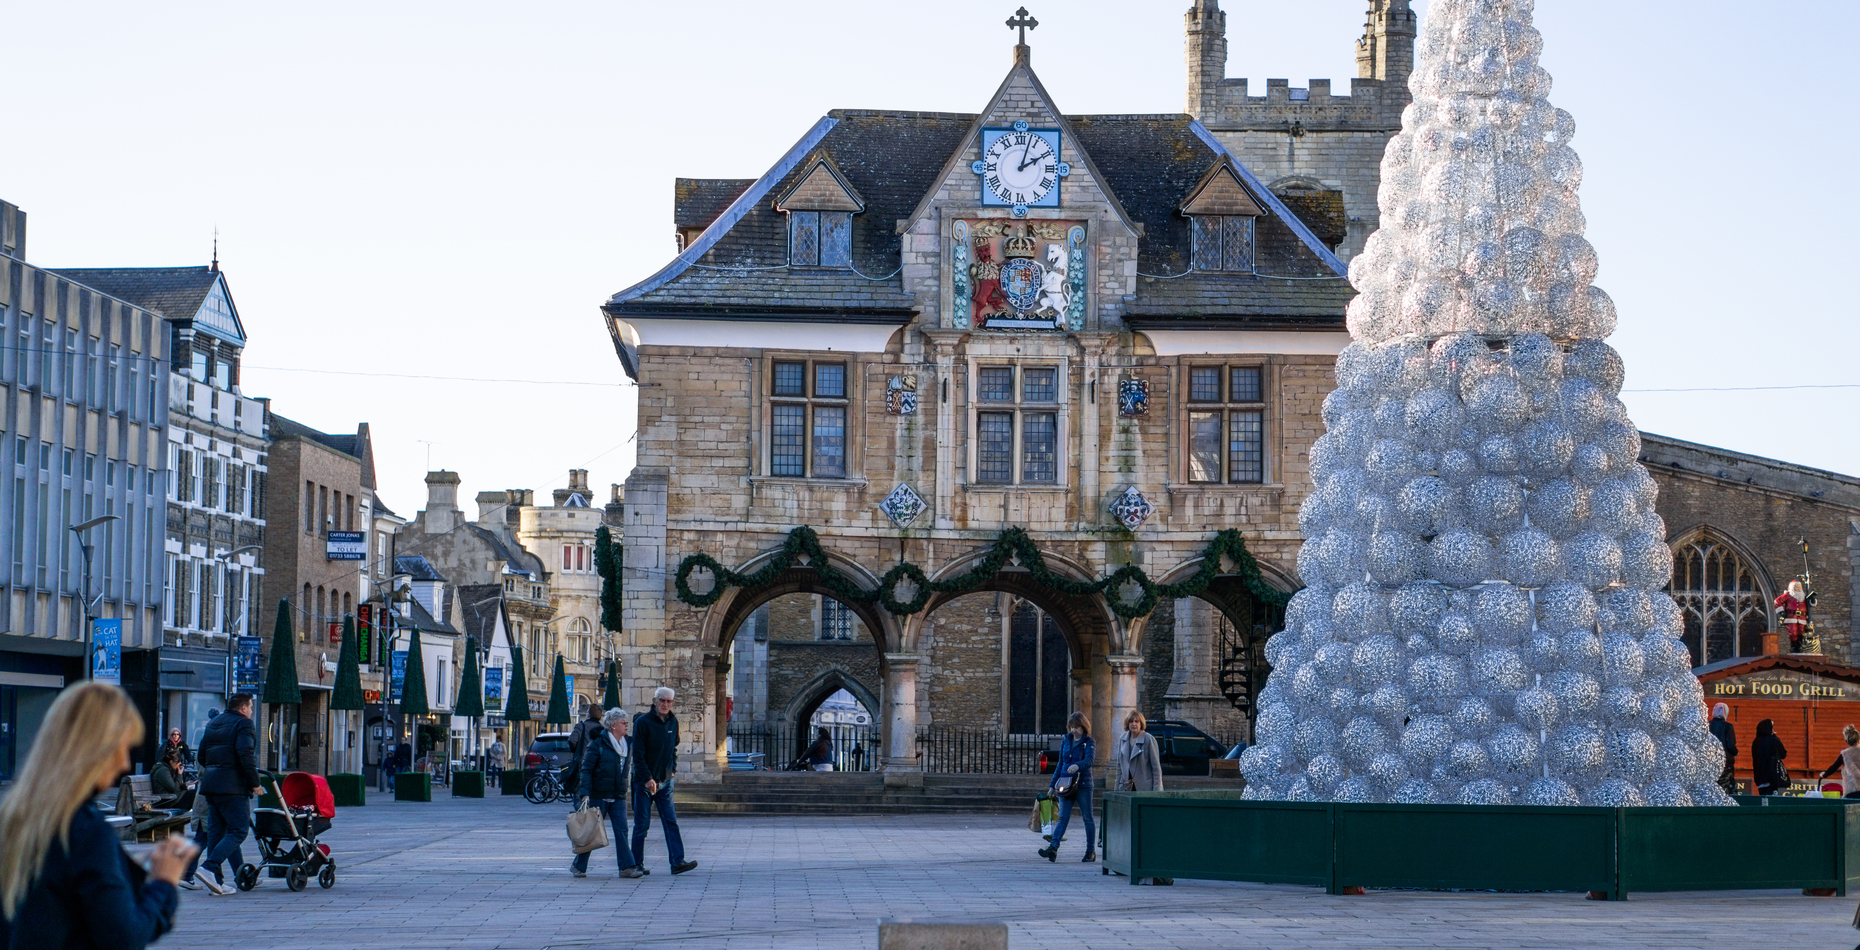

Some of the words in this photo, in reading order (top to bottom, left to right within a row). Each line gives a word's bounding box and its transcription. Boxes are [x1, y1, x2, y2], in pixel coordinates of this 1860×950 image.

[1001, 138, 1012, 150] XI
[1014, 136, 1027, 145] XII
[990, 150, 1001, 159] X
[360, 606, 369, 662] CHIMICHANGA
[1714, 683, 1746, 695] HOT
[1751, 682, 1793, 695] FOOD
[1799, 682, 1846, 697] GRILL
